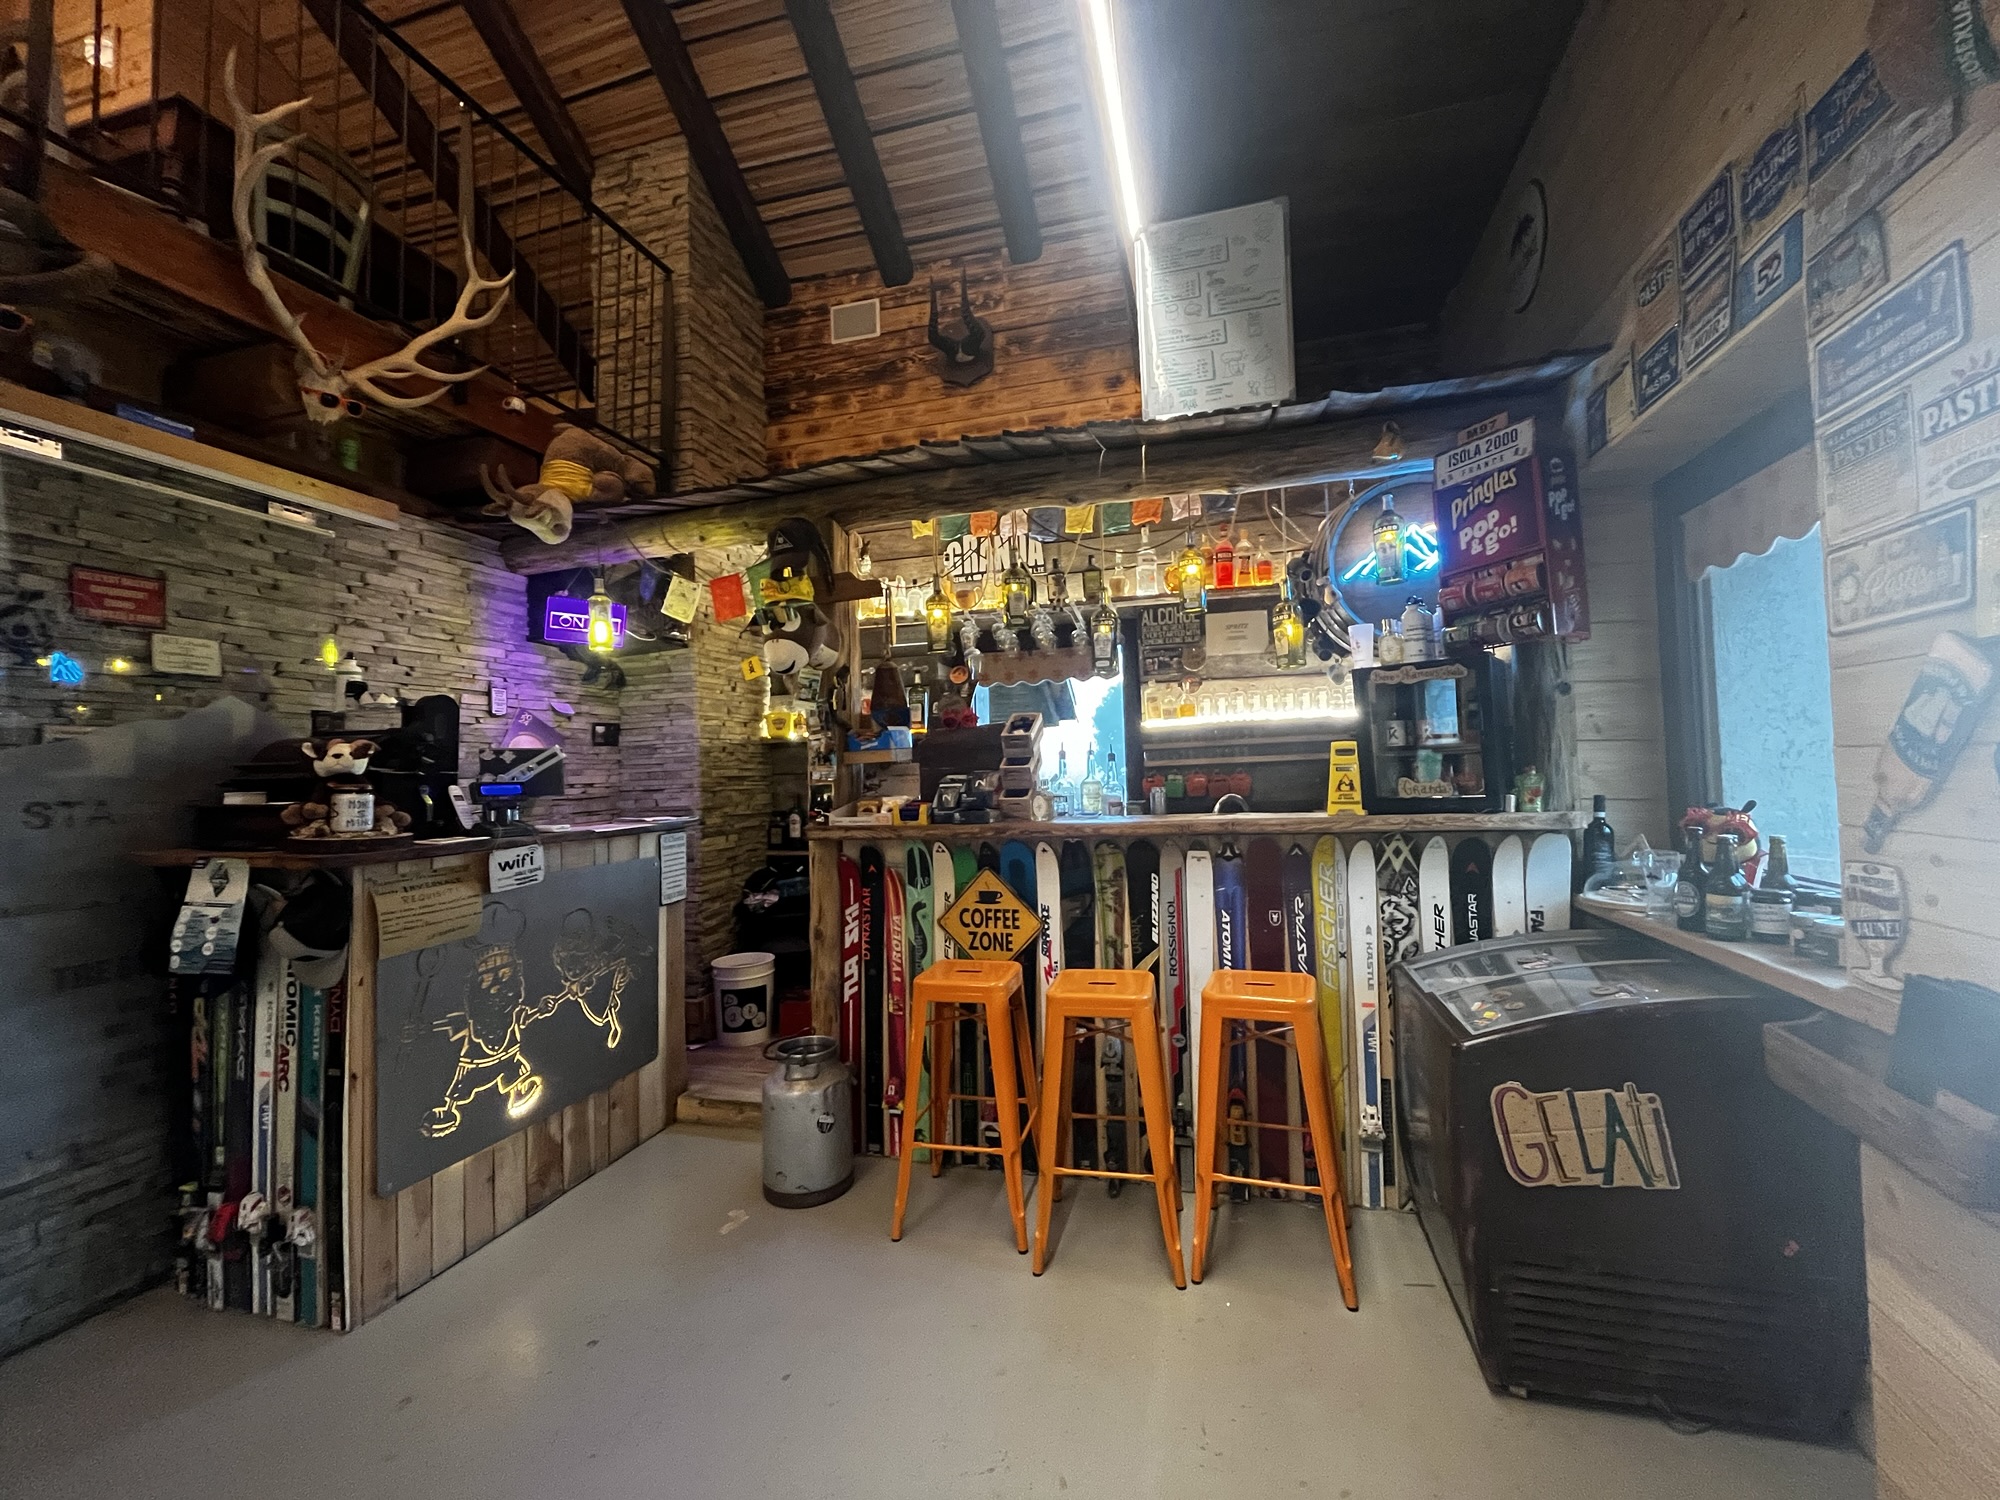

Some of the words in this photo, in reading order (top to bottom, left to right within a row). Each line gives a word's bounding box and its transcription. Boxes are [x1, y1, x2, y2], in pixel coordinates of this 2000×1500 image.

[1448, 443, 1482, 468] ISOLA
[1485, 428, 1518, 453] 2000
[1451, 467, 1518, 531] Pringles
[497, 851, 536, 873] wifi
[844, 902, 861, 950] SKI
[862, 886, 872, 961] DYNASTAR
[958, 908, 1021, 930] COFFEE
[967, 930, 1014, 952] ZONE
[1166, 900, 1178, 978] ROSSIGNOL
[1318, 861, 1339, 992] FISCHER
[1432, 902, 1446, 951] HER
[277, 1043, 291, 1093] ARC
